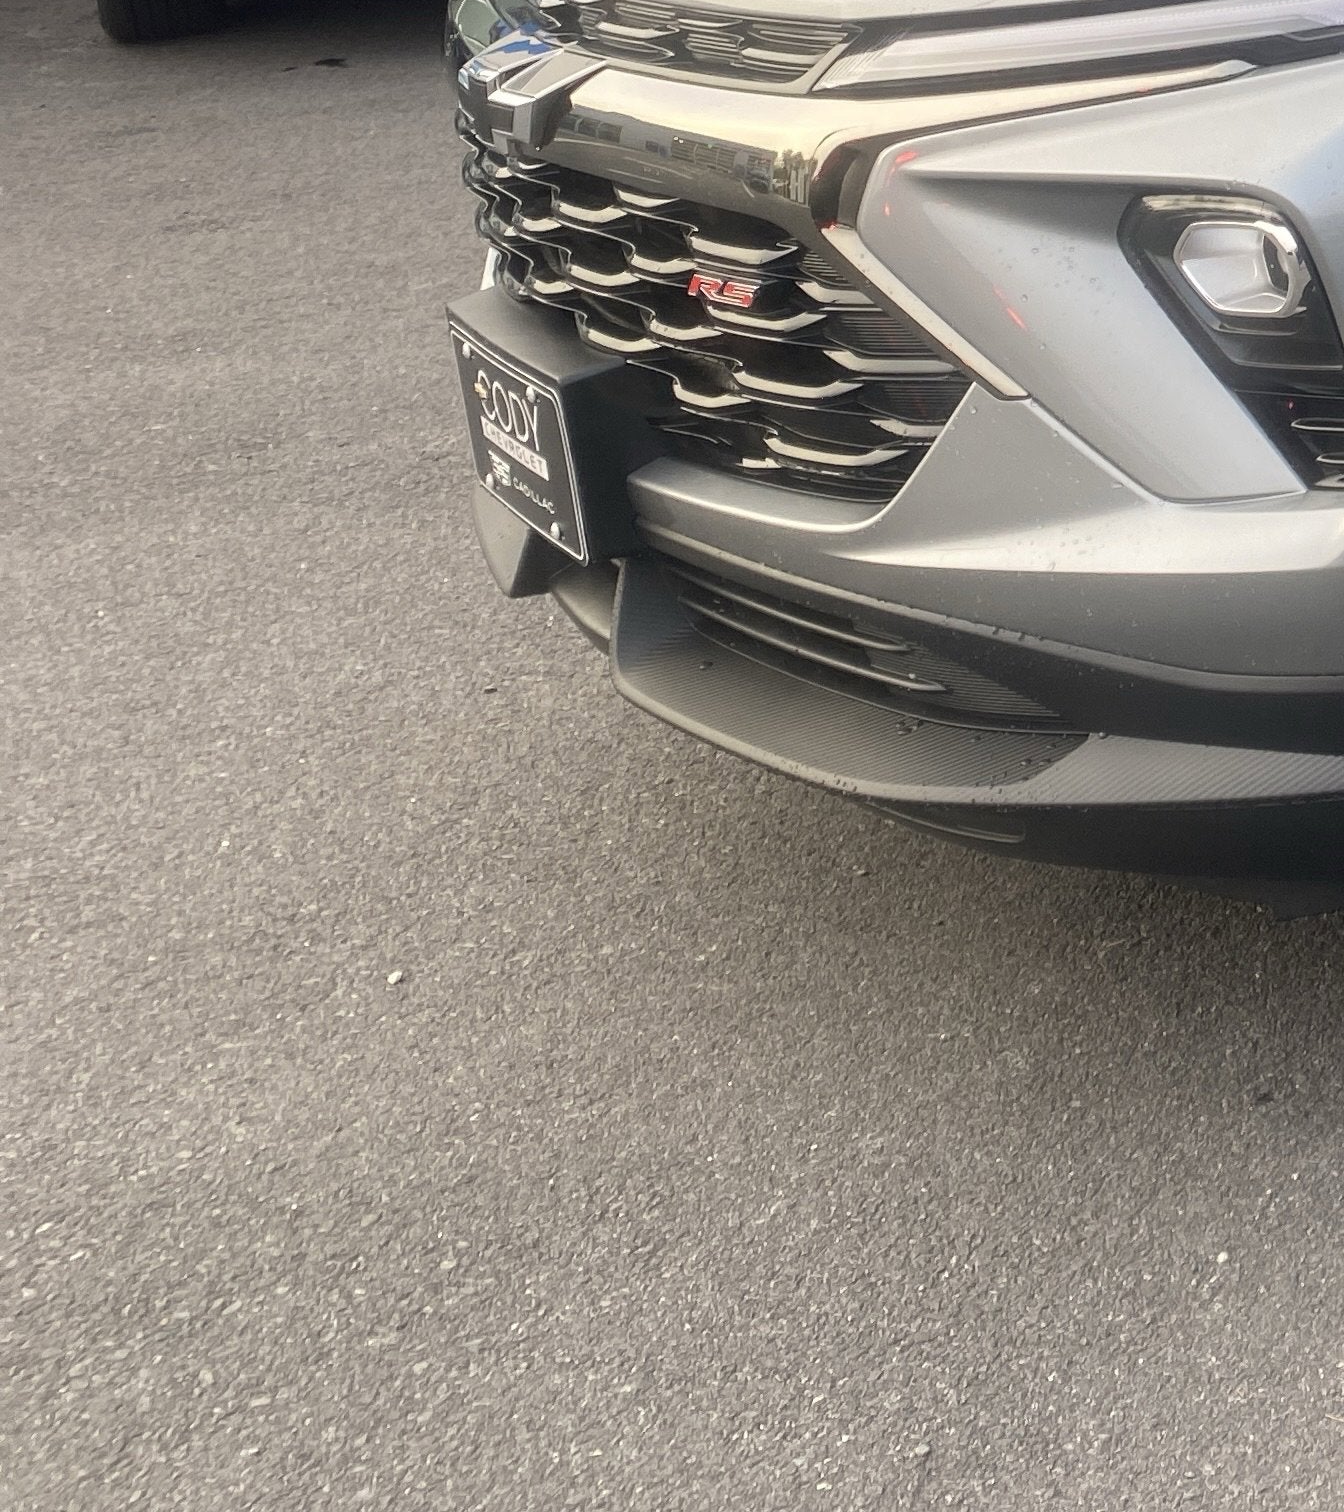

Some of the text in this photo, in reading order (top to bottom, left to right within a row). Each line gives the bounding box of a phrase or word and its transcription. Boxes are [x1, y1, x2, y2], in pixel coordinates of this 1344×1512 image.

[687, 273, 760, 308] RS
[477, 369, 540, 452] CODY
[484, 420, 546, 474] CHEVROLET
[512, 475, 556, 515] CADILLAC
